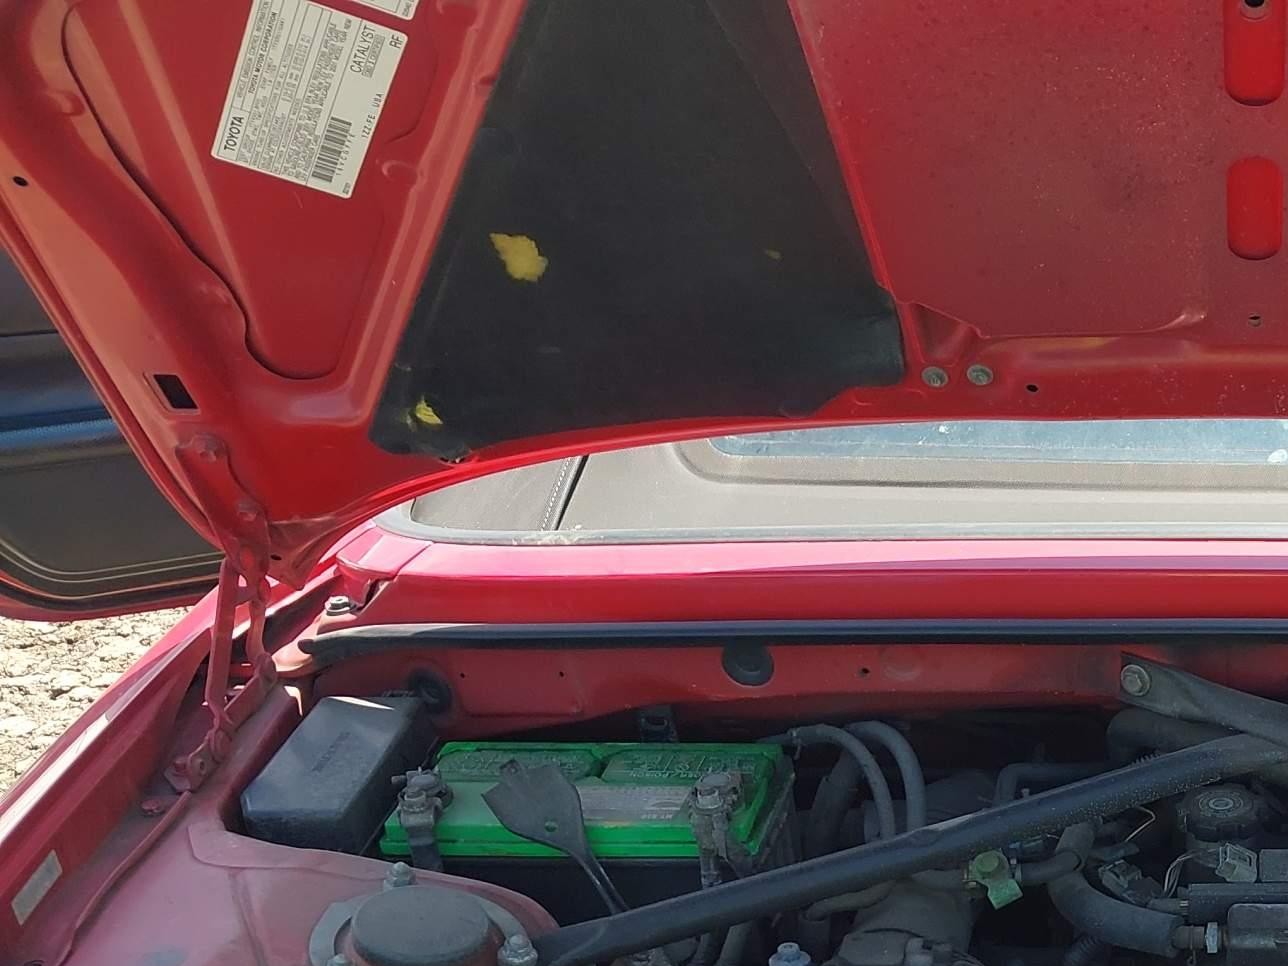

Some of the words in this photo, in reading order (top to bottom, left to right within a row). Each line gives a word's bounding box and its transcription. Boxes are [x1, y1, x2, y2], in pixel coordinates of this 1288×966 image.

[253, 53, 265, 73] MOTOR
[259, 10, 277, 52] CORPORATION
[348, 24, 376, 74] CATALYST
[388, 33, 404, 49] RF
[371, 91, 383, 107] USA
[223, 114, 244, 152] TOYOTA
